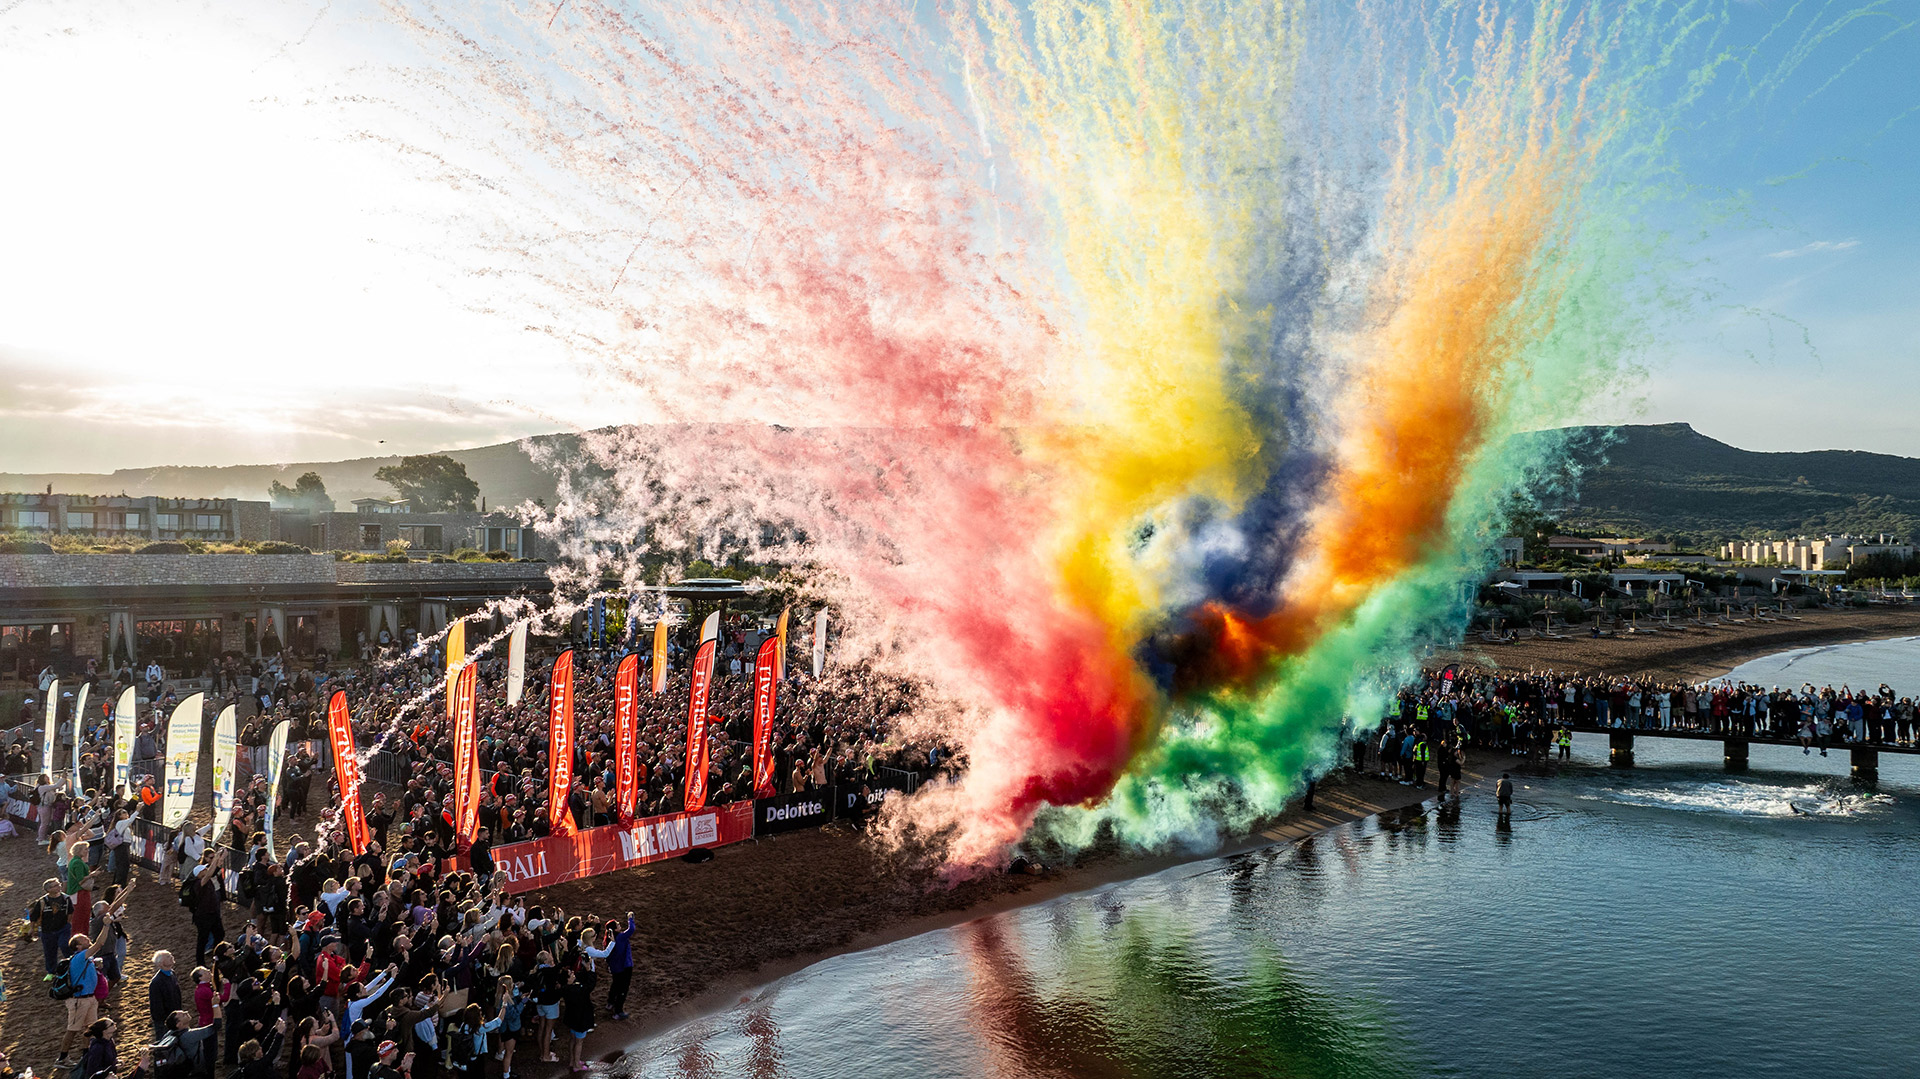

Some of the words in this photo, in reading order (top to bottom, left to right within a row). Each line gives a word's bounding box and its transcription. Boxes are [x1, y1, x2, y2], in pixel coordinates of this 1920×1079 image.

[553, 682, 570, 789] GENERALI
[619, 684, 633, 785] GENERALI
[618, 824, 658, 862] HERE
[655, 817, 689, 854] NOW
